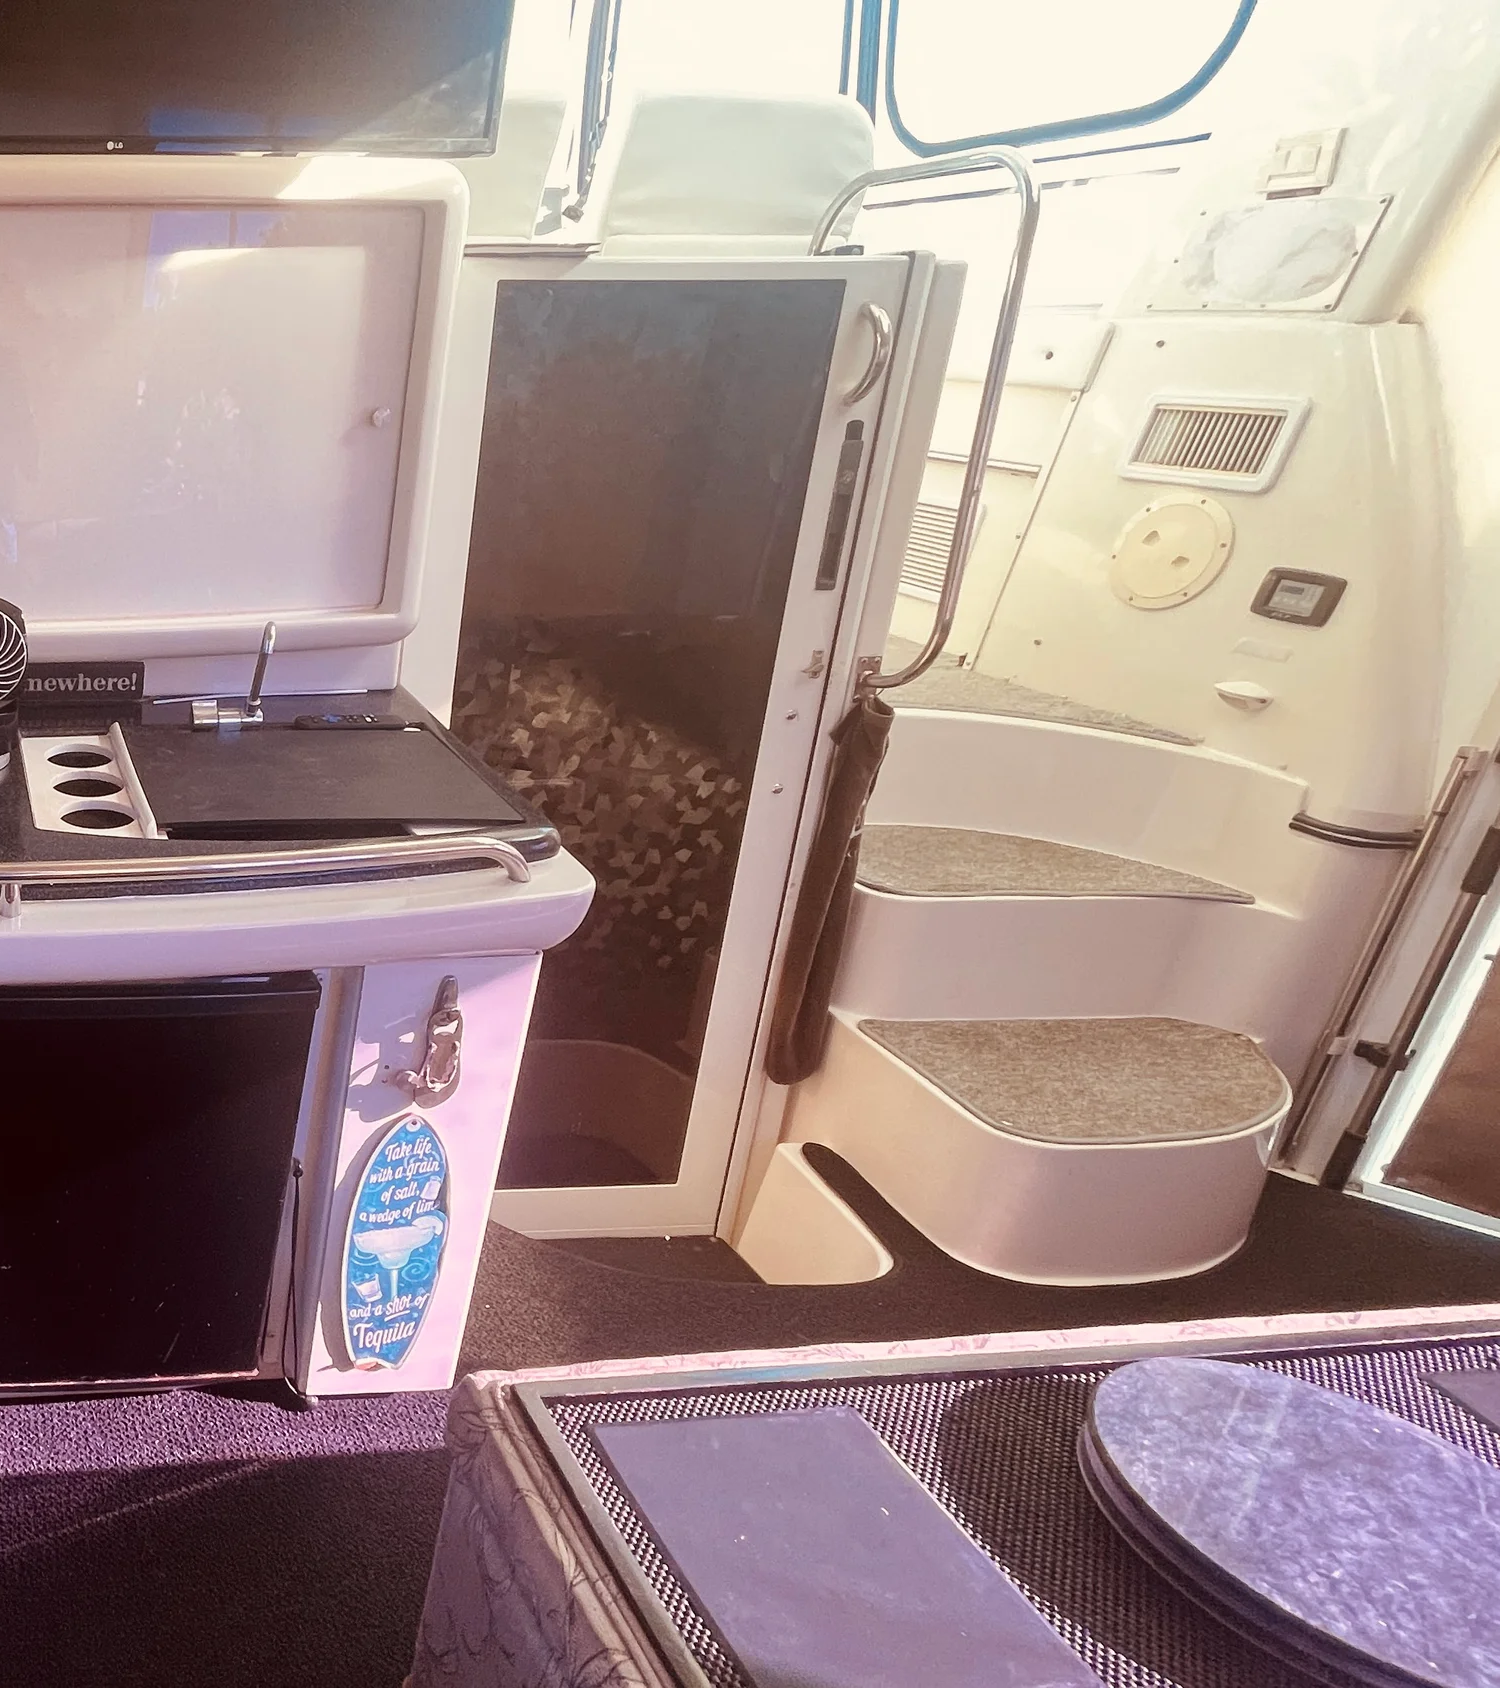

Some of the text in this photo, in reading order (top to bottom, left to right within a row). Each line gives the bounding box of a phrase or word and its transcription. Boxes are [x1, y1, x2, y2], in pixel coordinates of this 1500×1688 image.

[385, 1136, 432, 1162] Take life
[369, 1157, 440, 1184] with a grain
[381, 1181, 420, 1205] of salt,
[359, 1212, 368, 1222] a
[368, 1208, 401, 1225] wedge
[402, 1201, 417, 1219] of
[349, 1293, 430, 1318] and a shot of
[353, 1321, 416, 1353] Tequila
